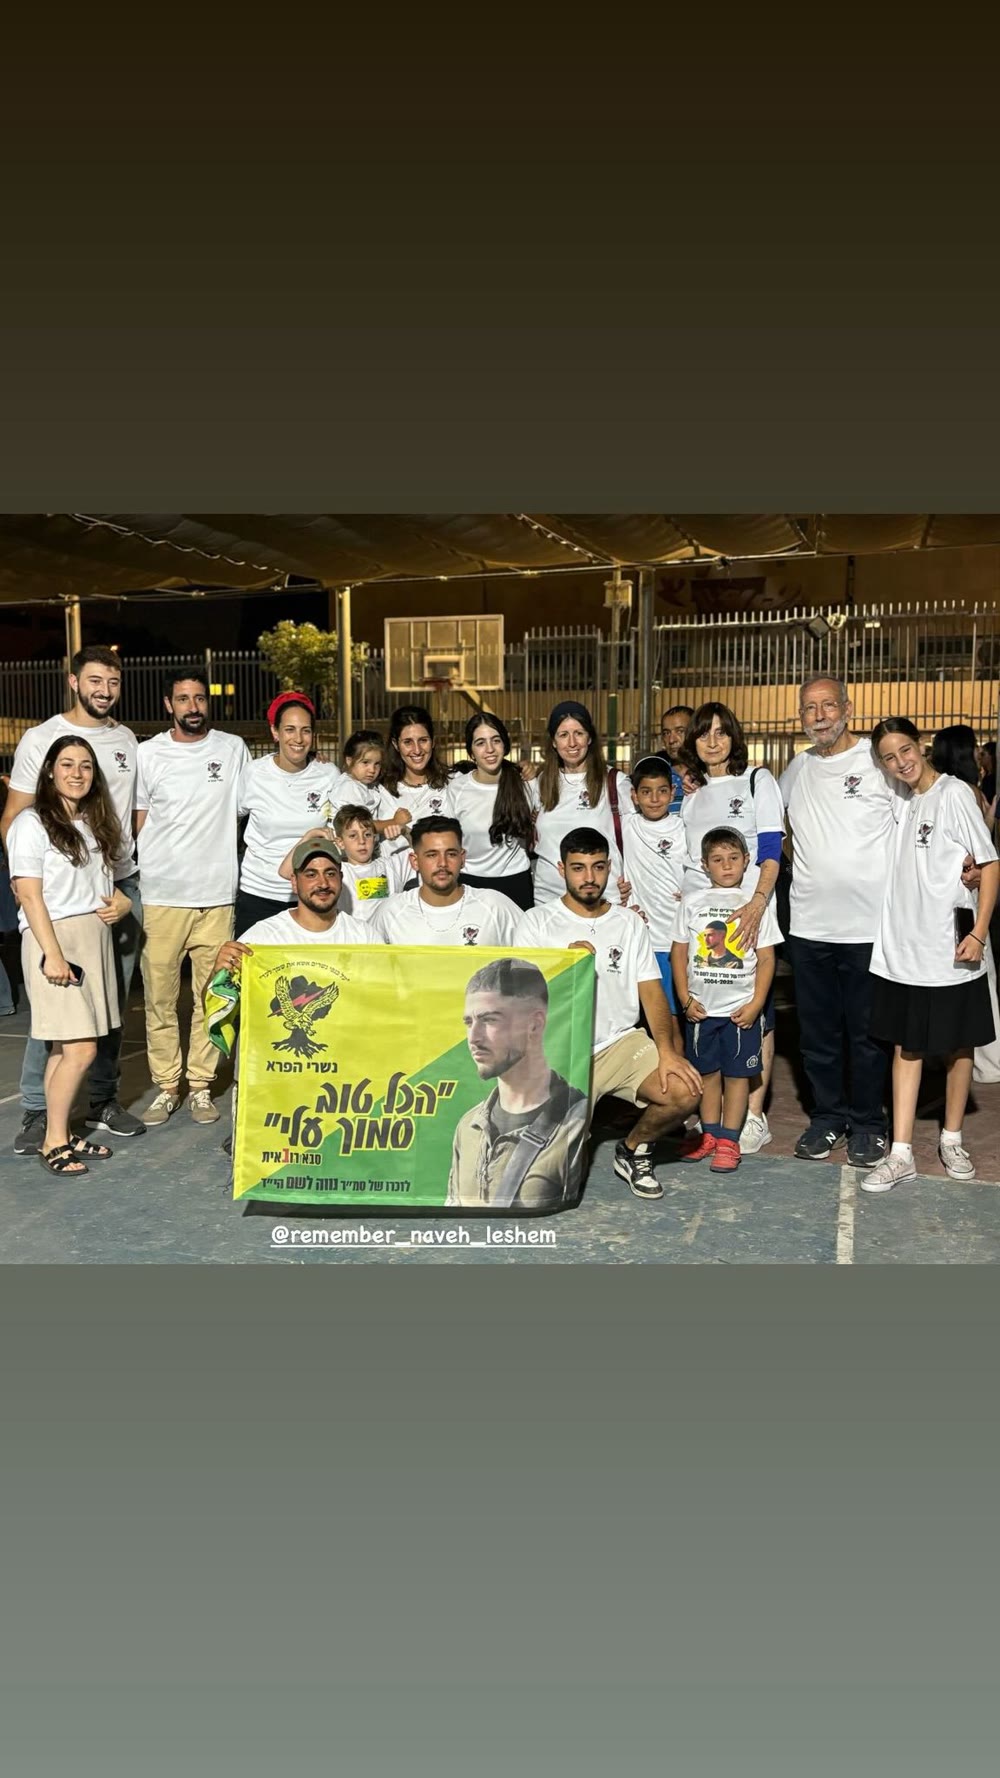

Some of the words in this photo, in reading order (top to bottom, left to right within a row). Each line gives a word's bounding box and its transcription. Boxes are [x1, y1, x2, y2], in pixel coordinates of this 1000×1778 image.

[311, 961, 329, 970] נשרים
[265, 1059, 303, 1073] הפרא
[306, 1061, 338, 1074] נשרי
[314, 1077, 373, 1115] טוב
[336, 1116, 415, 1155] סמוך
[826, 1132, 837, 1145] N
[302, 1153, 322, 1165] סבא
[286, 1174, 313, 1190] לשם
[315, 1176, 339, 1191] נווה
[368, 1179, 384, 1192] של
[385, 1179, 411, 1192] לזכרו
